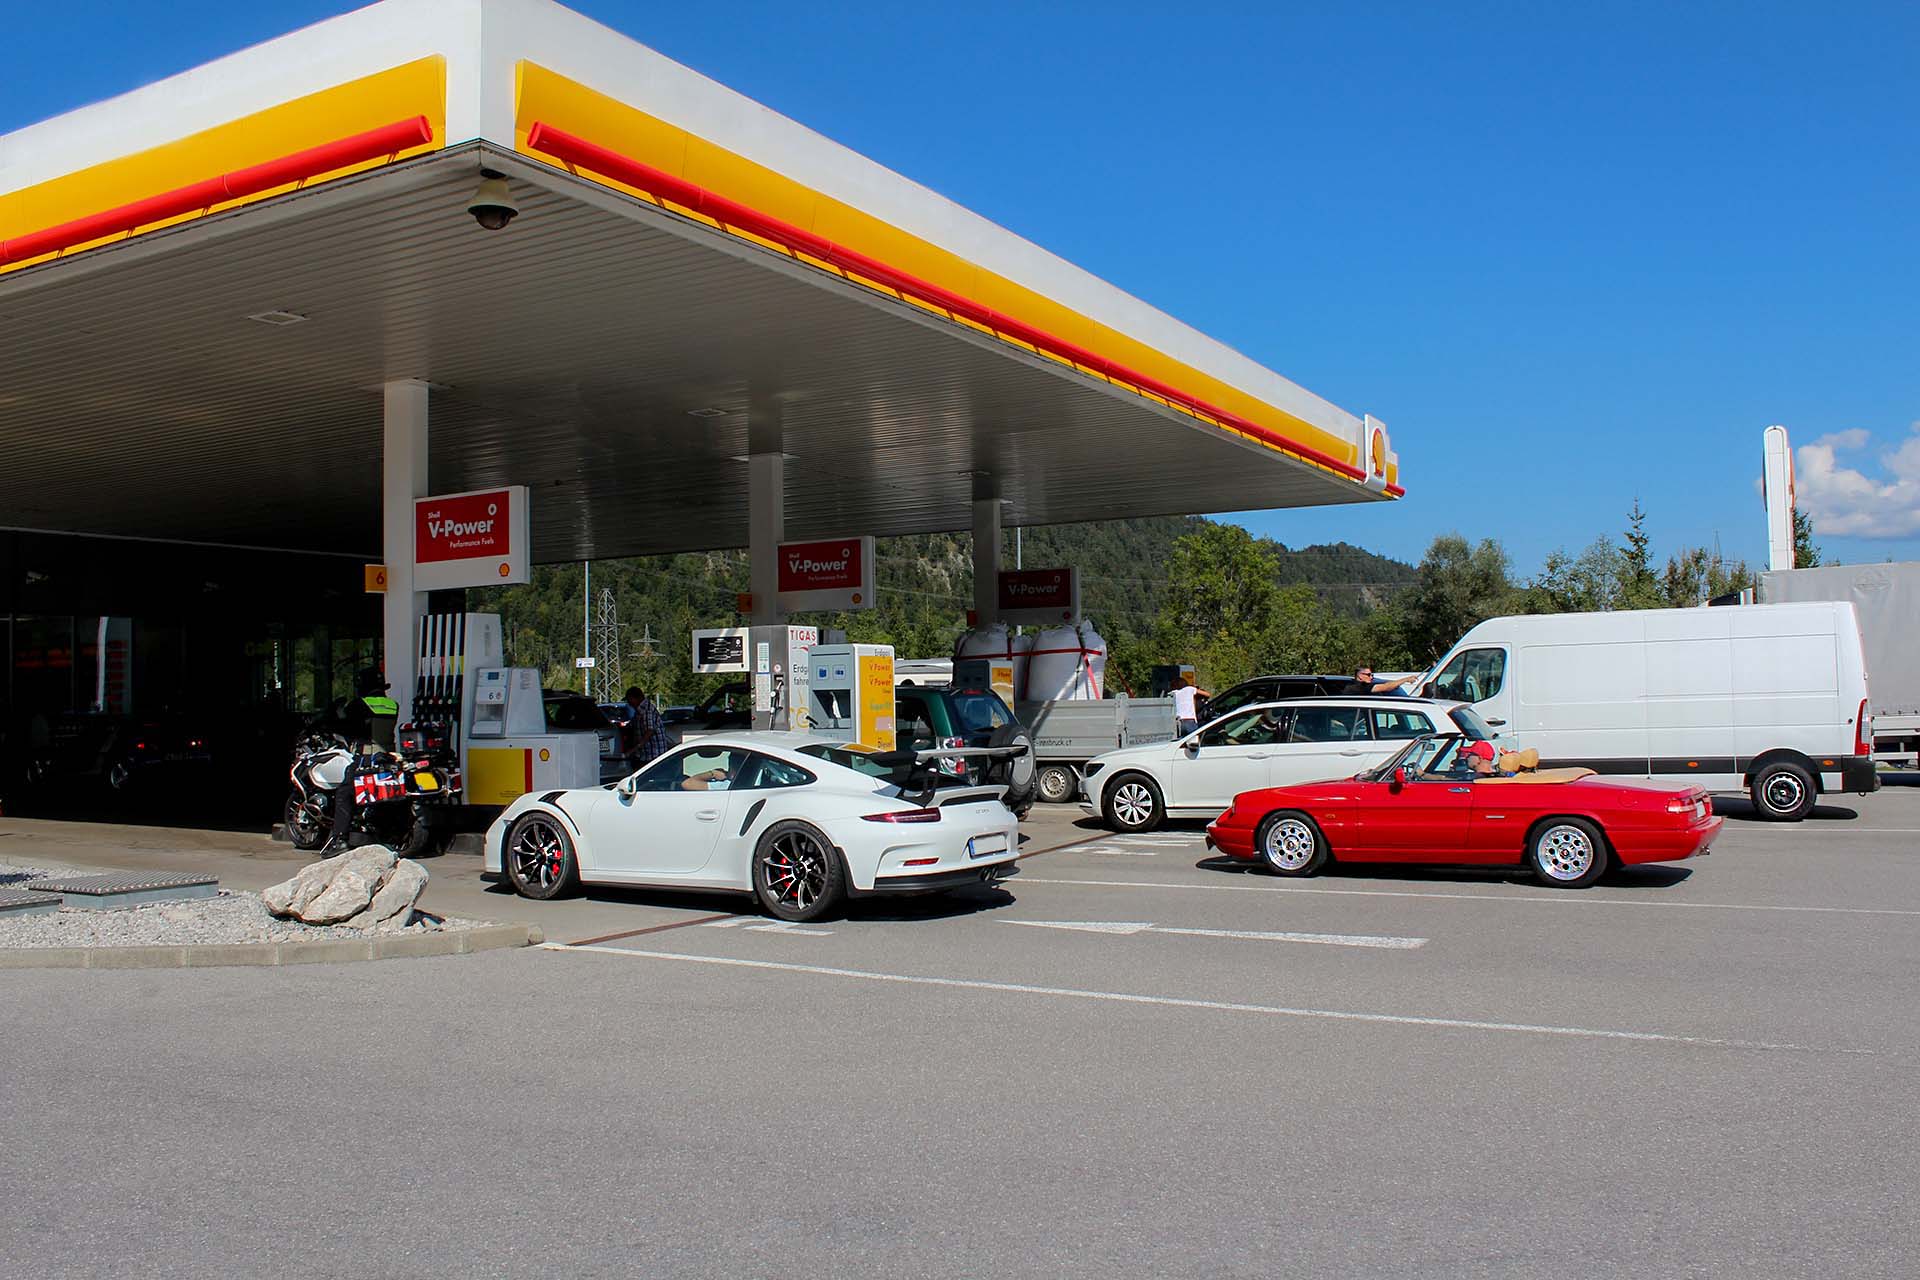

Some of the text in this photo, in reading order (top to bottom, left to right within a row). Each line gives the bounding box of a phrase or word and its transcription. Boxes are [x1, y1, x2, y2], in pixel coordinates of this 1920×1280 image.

[428, 511, 441, 519] Shell
[428, 519, 494, 539] V-Power
[789, 559, 848, 574] V-Power
[376, 571, 385, 585] 6
[1008, 583, 1059, 595] V-Power
[790, 630, 816, 641] TIGAS
